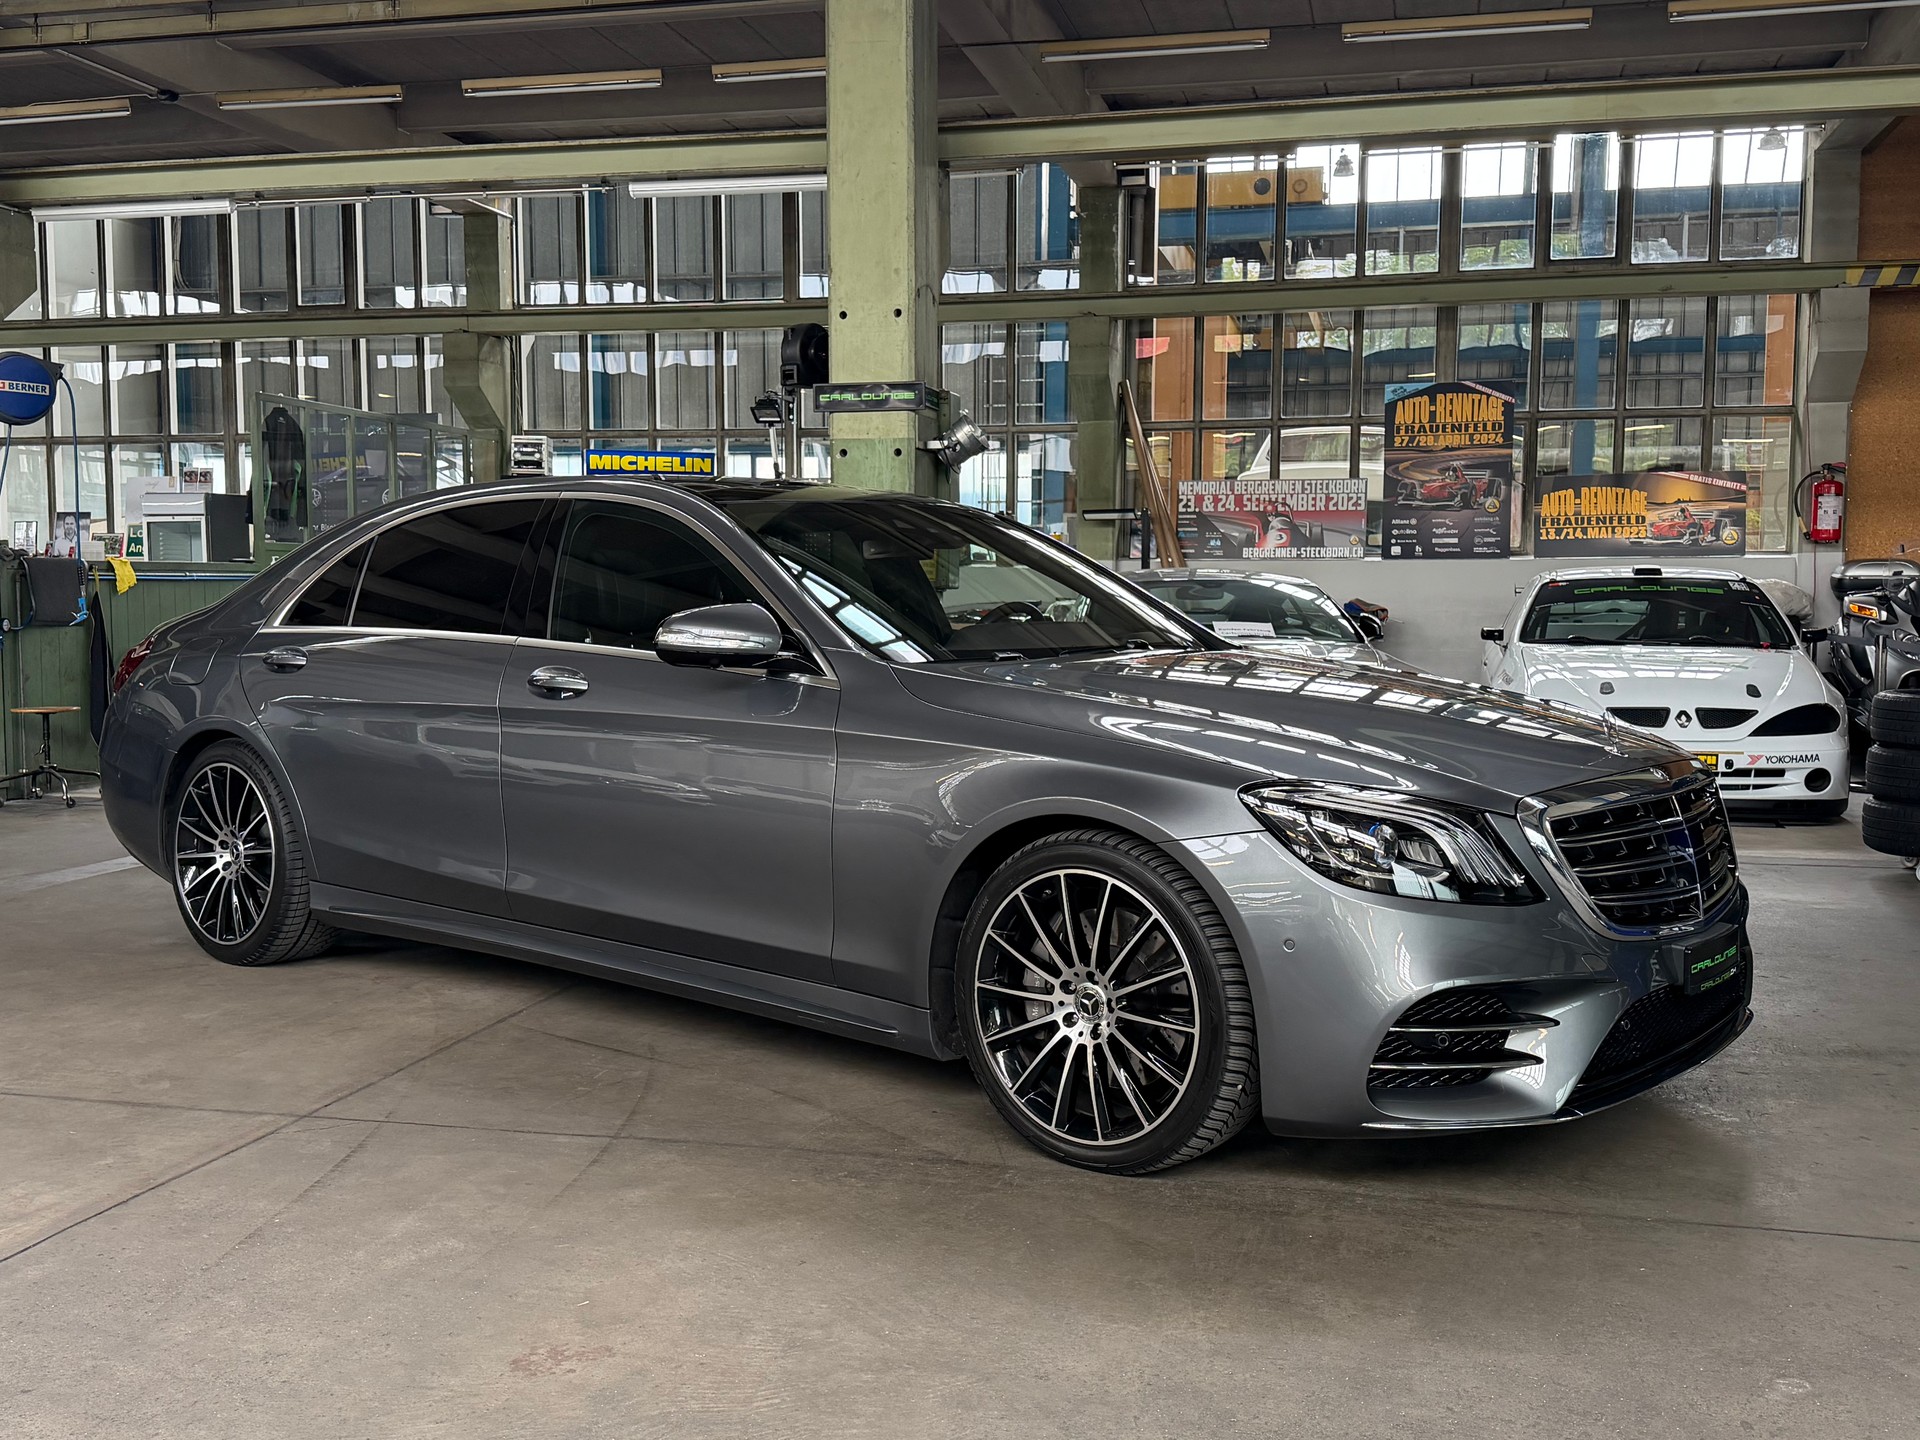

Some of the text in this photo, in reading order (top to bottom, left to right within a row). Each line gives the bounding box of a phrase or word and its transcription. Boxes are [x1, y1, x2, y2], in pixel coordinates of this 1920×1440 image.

[8, 382, 47, 394] BERNER
[819, 392, 916, 402] CARLOUNGE
[1395, 393, 1505, 424] AUTO-RENNTAGE
[1395, 422, 1503, 435] FRAUENFELD
[1473, 434, 1504, 445] 2024
[590, 455, 712, 472] MICHELIN
[1179, 479, 1366, 495] MEMORIAL BERGRENNEN STECKBORN
[1178, 495, 1200, 513] 23.
[1202, 495, 1215, 512] &
[1218, 495, 1240, 512] 24.
[1328, 493, 1366, 511] 2023
[1541, 487, 1648, 517] AUTO-RENNTAGE
[1541, 515, 1646, 527] FRAUENFELD
[1614, 526, 1648, 539] 2023
[1242, 547, 1364, 558] BERGRENNEN-STECKBORN.CH
[1574, 585, 1724, 595] CARLOUNGE
[1764, 753, 1821, 765] YOKOHAMA
[1690, 945, 1737, 975] CARLOUNGE
